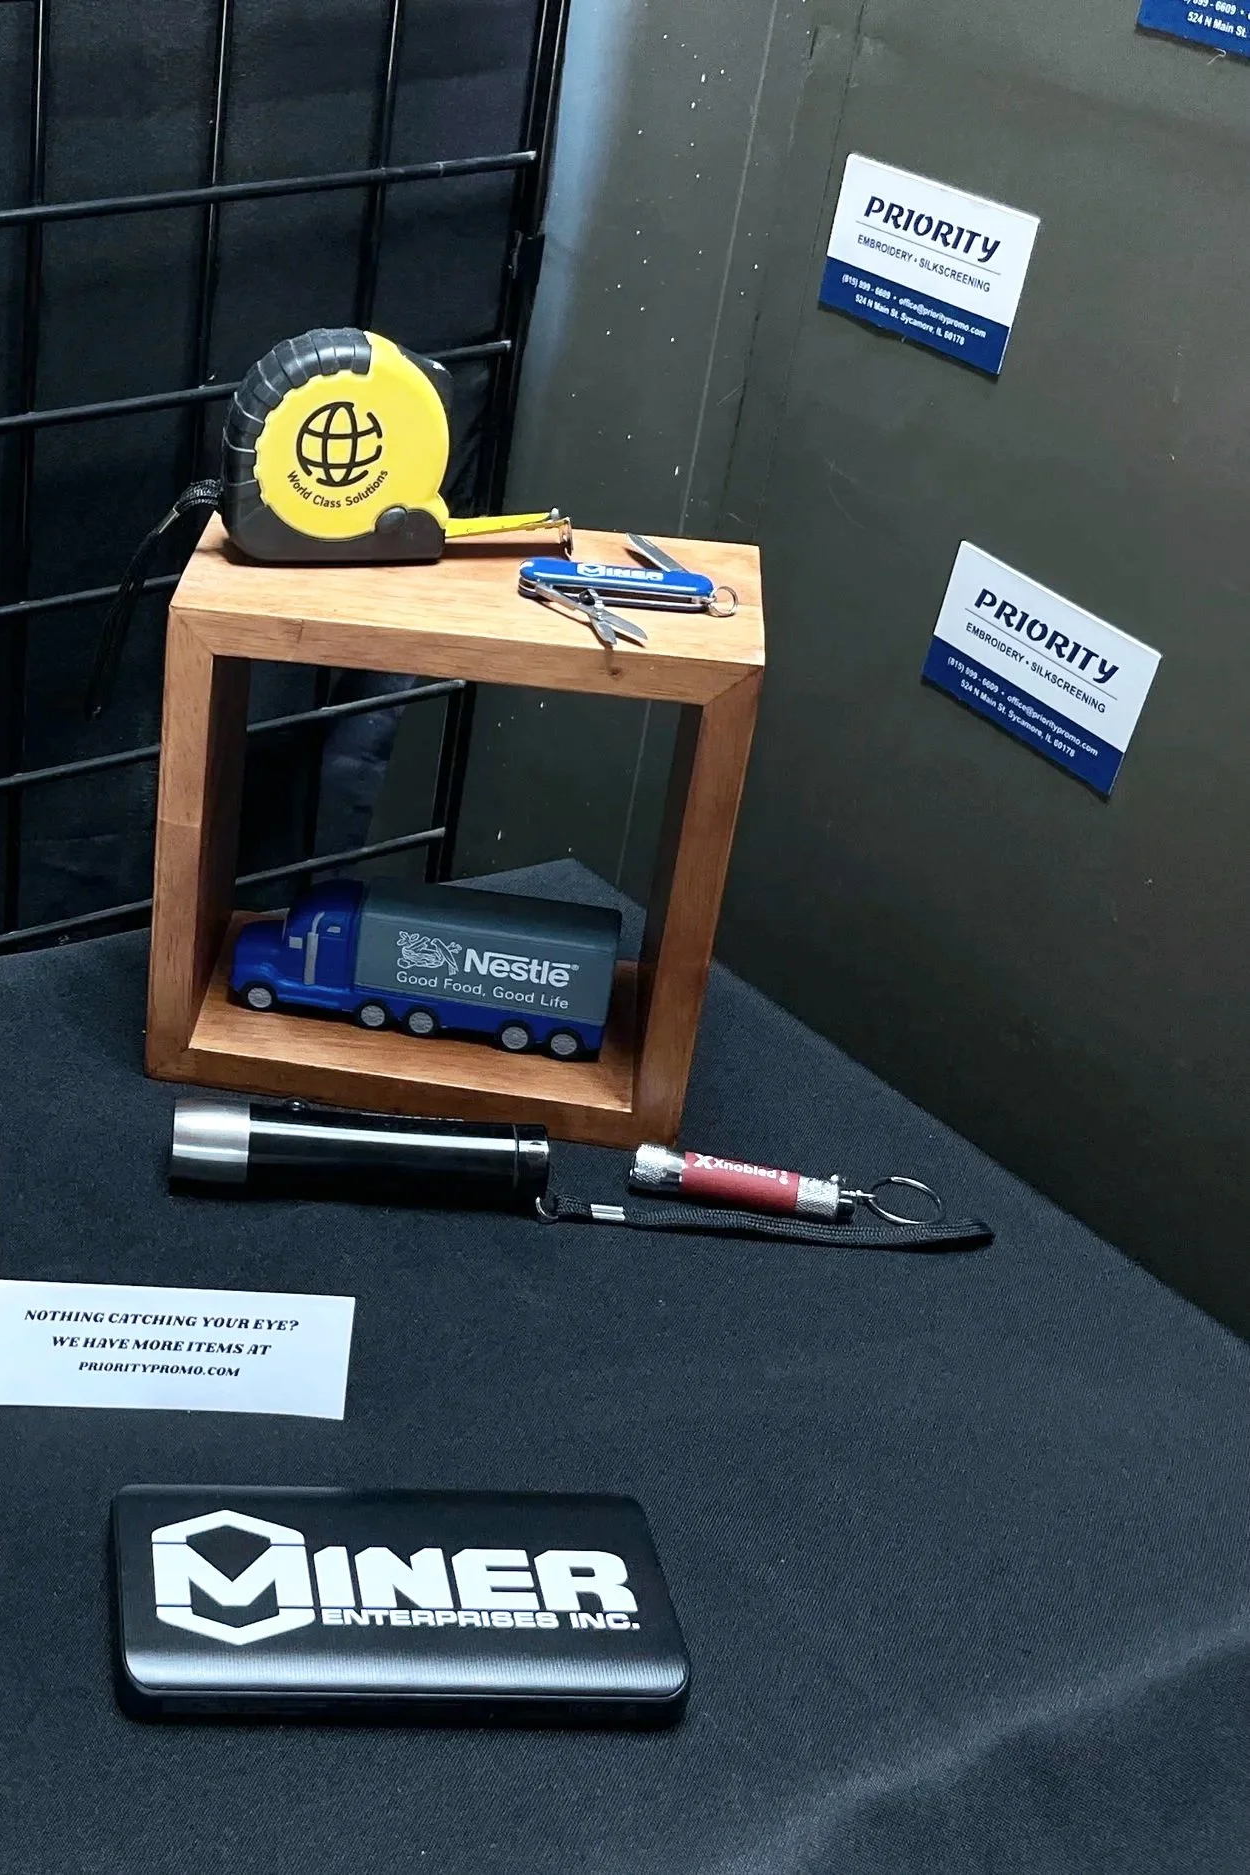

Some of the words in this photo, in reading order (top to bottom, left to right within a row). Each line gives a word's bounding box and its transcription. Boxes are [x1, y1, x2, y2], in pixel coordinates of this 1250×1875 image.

[1187, 11, 1203, 25] 524
[1204, 16, 1213, 27] N
[1213, 18, 1234, 34] Main
[1215, 1, 1237, 15] 6609
[863, 195, 1001, 263] PRIORITY
[857, 234, 913, 263] EMBROIDERY
[918, 258, 991, 293] SILKSCREENING
[867, 298, 874, 308] N
[874, 301, 889, 315] Main
[900, 312, 935, 335] Sycamore,
[944, 330, 966, 346] 60178
[898, 298, 987, 338] office@prioritypromo.com
[287, 470, 312, 500] World
[313, 494, 341, 508] Class
[345, 470, 388, 506] Solutions
[974, 588, 1119, 684] PRIORITY
[965, 622, 1024, 664] EMBROIDERY
[1030, 661, 1106, 714] SILKSCREENING
[960, 679, 973, 692] 524
[973, 687, 980, 697] N
[979, 691, 997, 707] Main
[1007, 709, 1044, 739] Sycamore,
[1053, 739, 1075, 758] 60178
[1006, 694, 1099, 757] office@prioritypromo.com
[396, 971, 438, 988] Good
[443, 978, 487, 997] Food,
[493, 986, 535, 1003] Good
[541, 994, 569, 1010] Life
[24, 1309, 105, 1323] NOTHING
[108, 1313, 197, 1328] CATCHING
[202, 1316, 250, 1330] YOUR
[253, 1319, 299, 1332] EYE?
[52, 1336, 80, 1348] WE
[82, 1337, 130, 1351] HAVE
[132, 1339, 185, 1352] MORE
[186, 1341, 243, 1355] ITEMS
[247, 1343, 272, 1356] AT
[78, 1361, 240, 1378] PRIORITYPROMO.COM
[152, 1509, 638, 1646] MINER
[321, 1607, 559, 1630] ENTERPRISES
[571, 1611, 640, 1630] INC.
